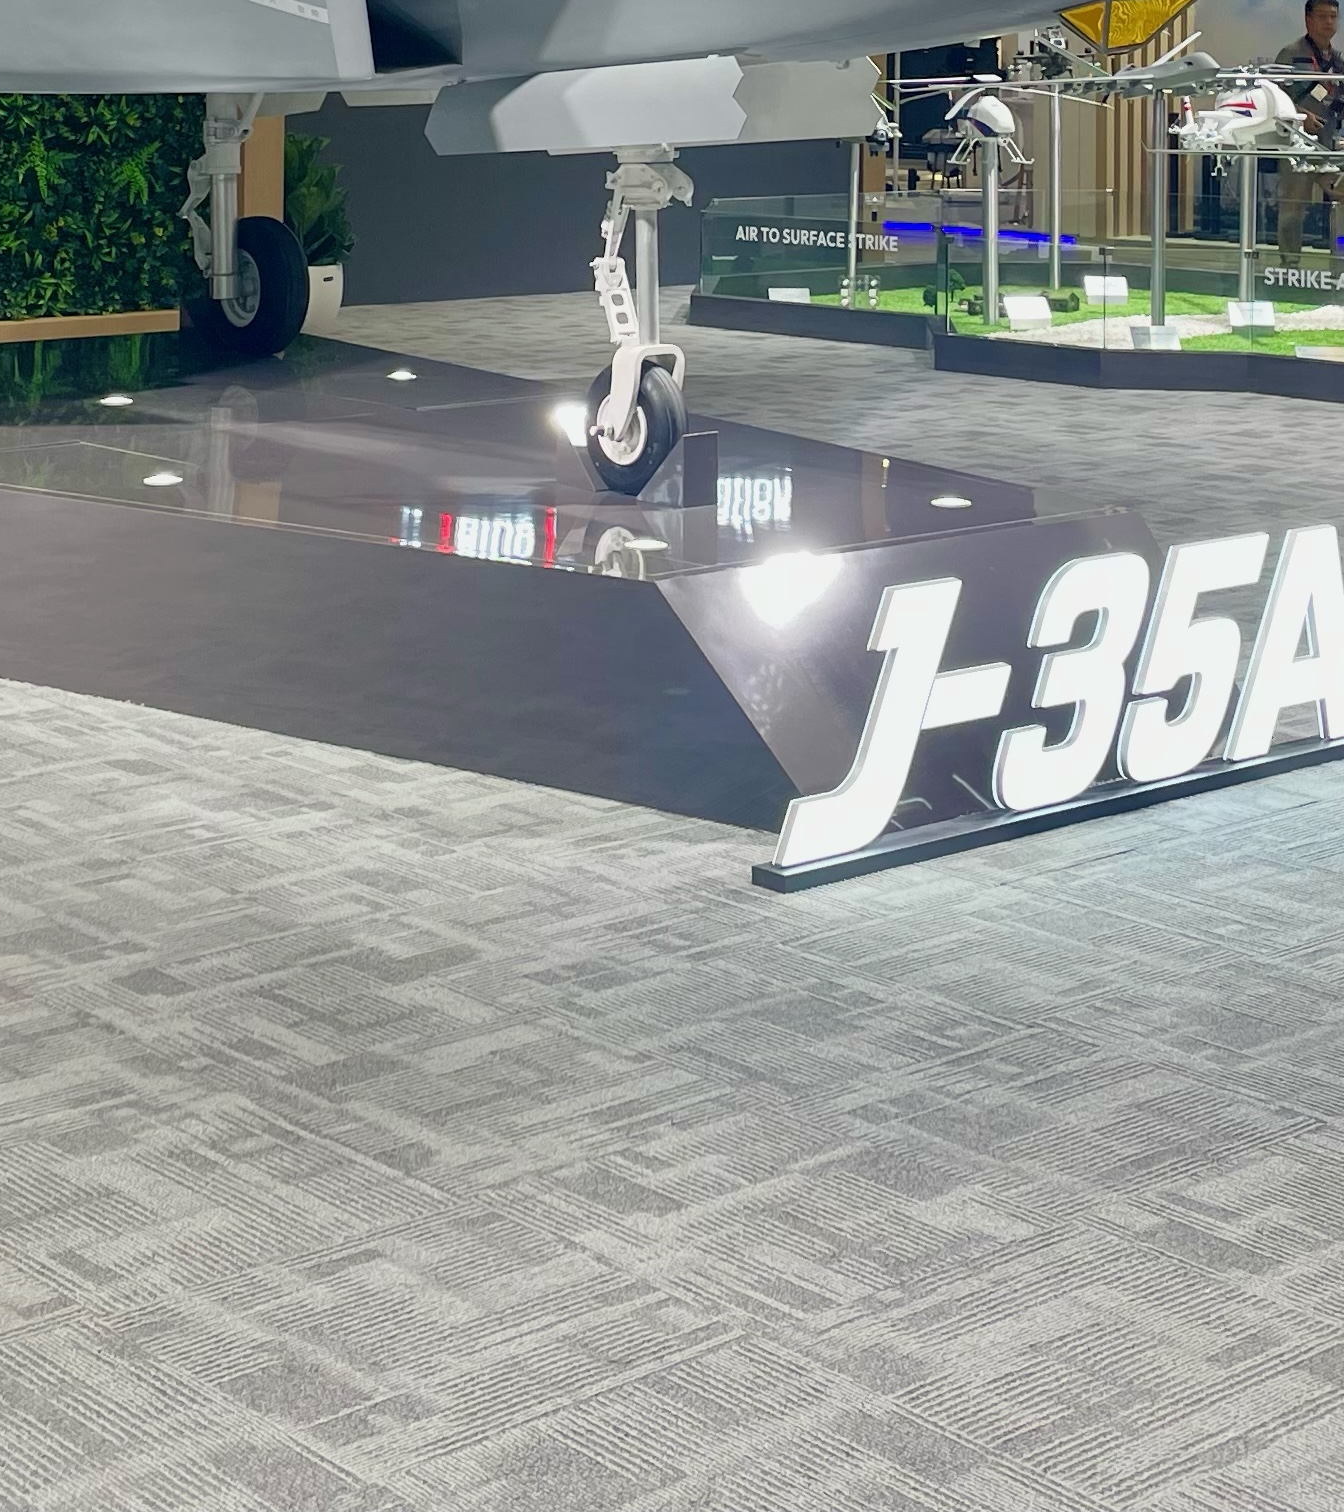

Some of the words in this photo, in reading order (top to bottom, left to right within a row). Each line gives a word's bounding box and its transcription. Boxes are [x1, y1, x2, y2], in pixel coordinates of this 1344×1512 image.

[735, 225, 758, 242] AIR
[760, 227, 780, 243] TO
[782, 228, 845, 248] SURFACE
[1264, 266, 1332, 291] STRIKE
